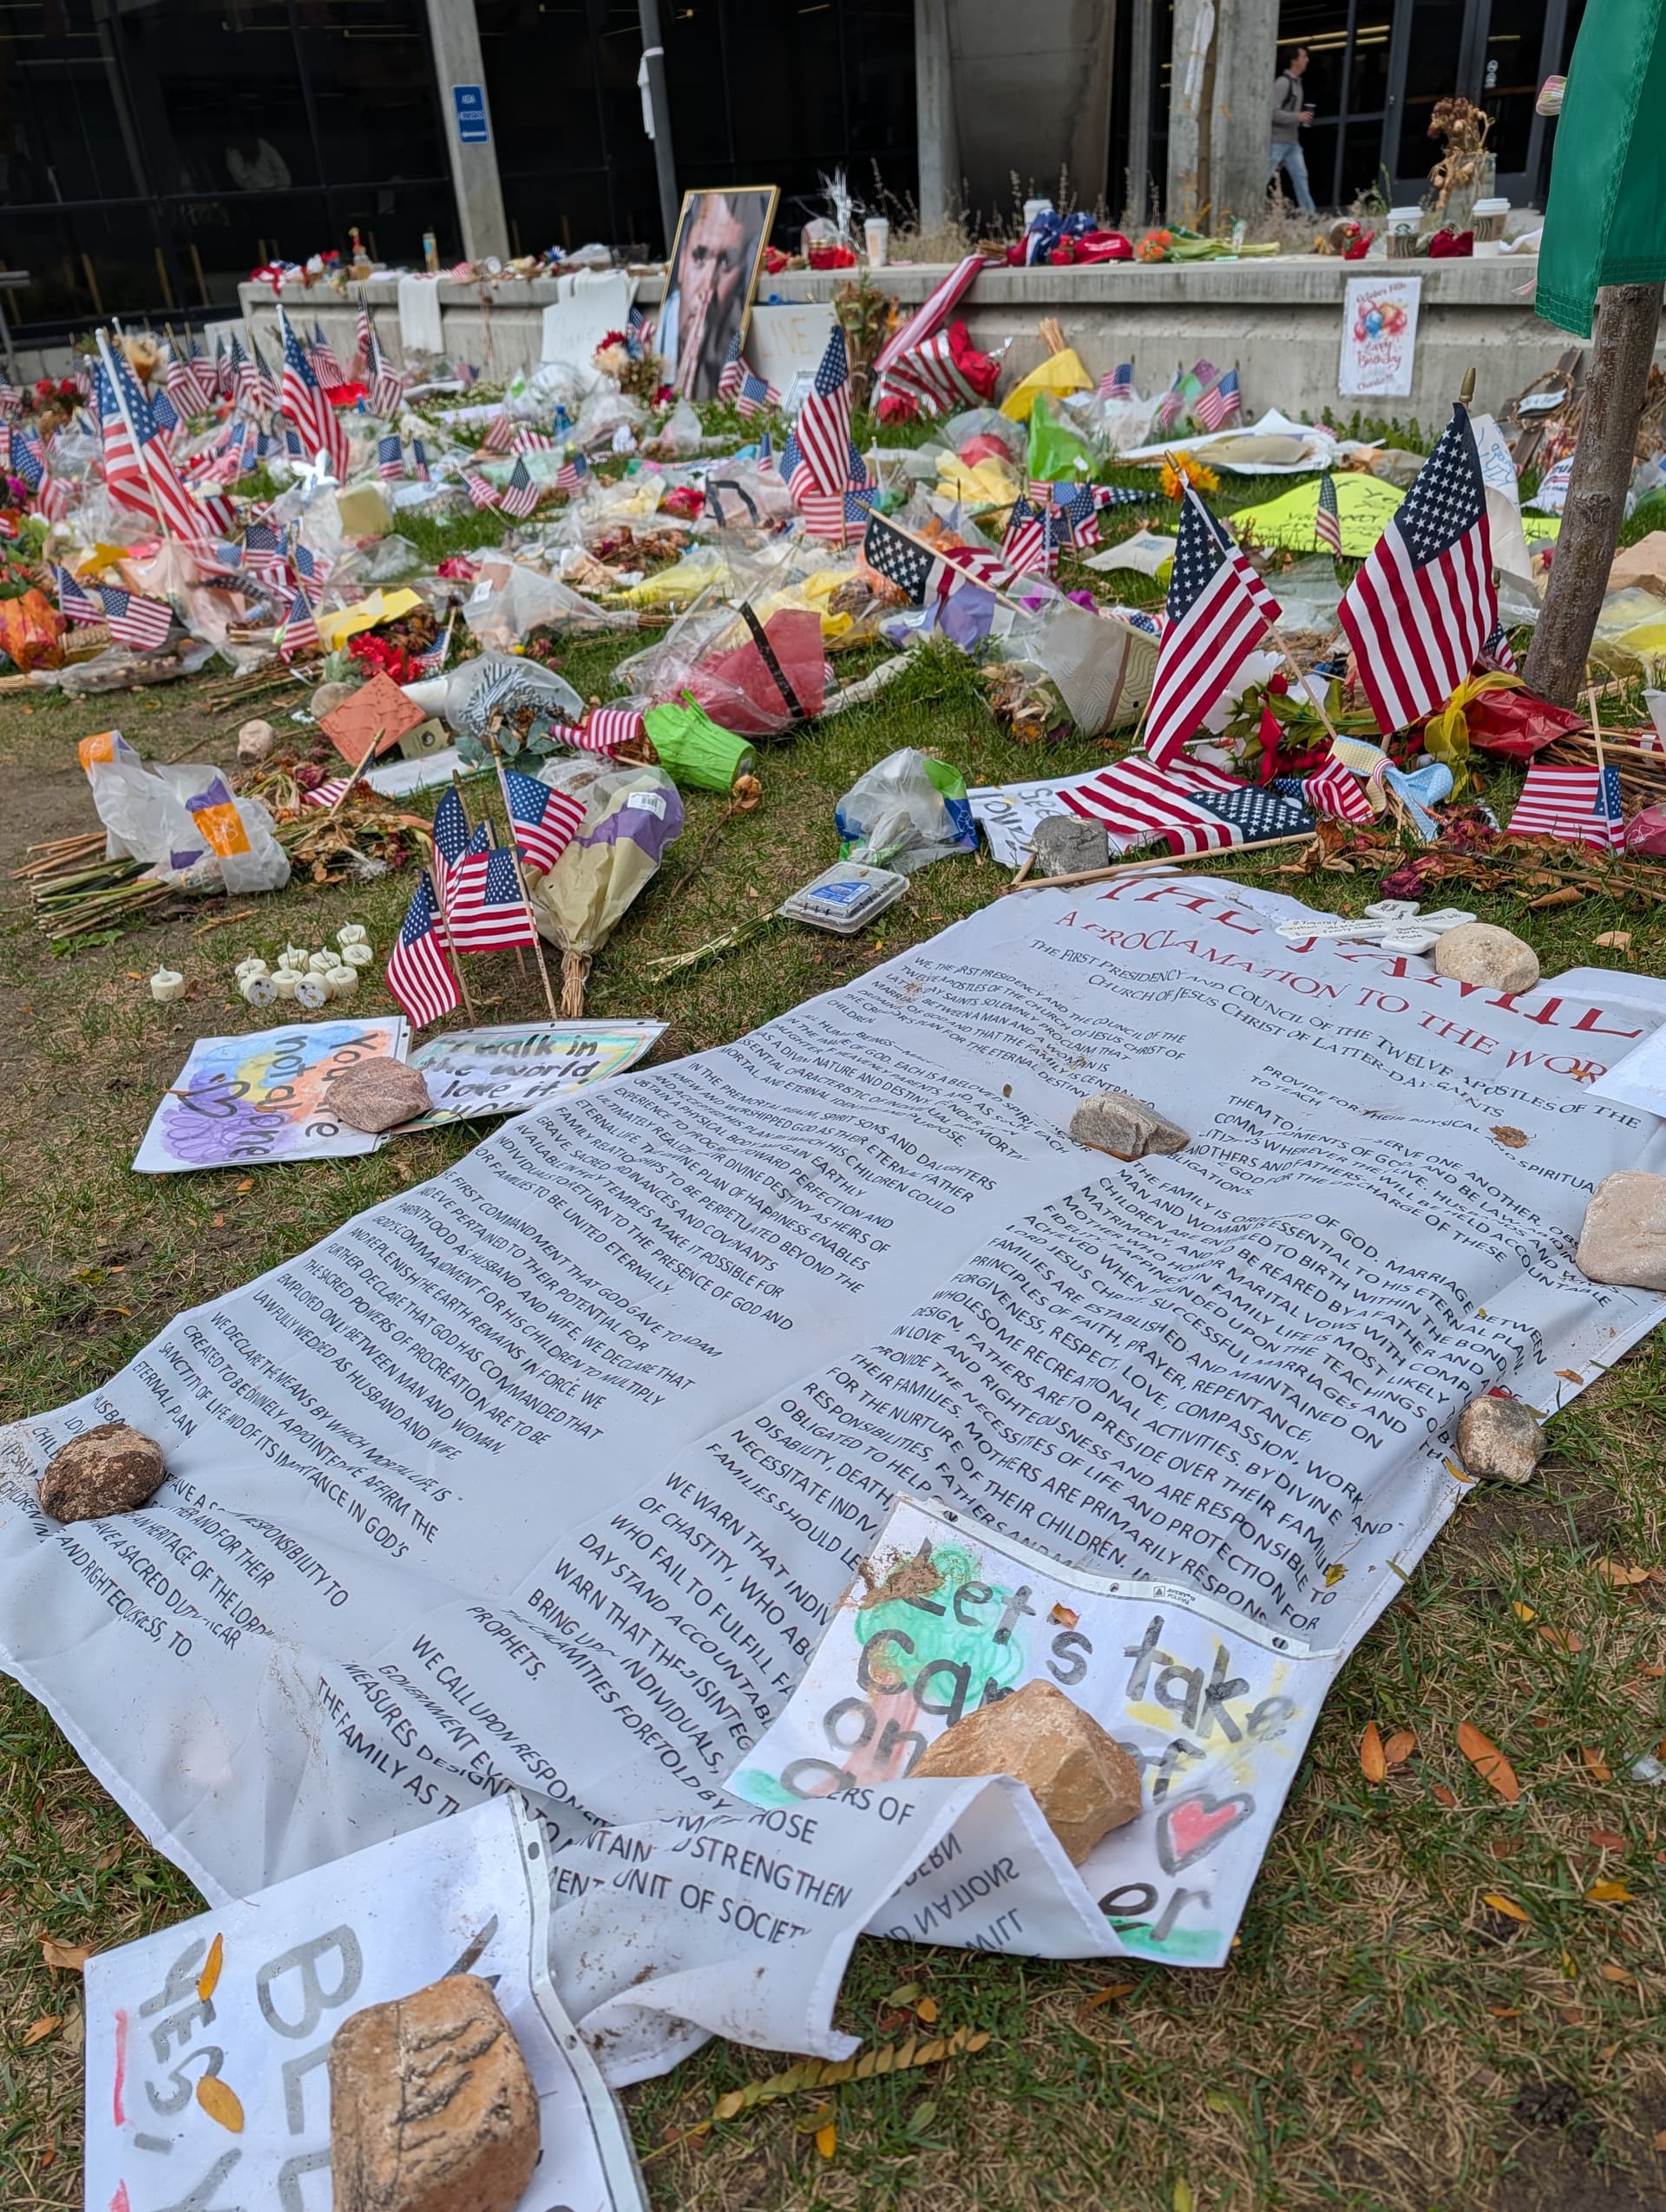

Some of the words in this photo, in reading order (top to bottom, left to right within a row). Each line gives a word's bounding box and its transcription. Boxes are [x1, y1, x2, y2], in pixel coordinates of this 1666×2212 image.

[1357, 350, 1401, 372] Birthday
[915, 957, 932, 971] WE,
[981, 967, 1044, 998] PRESIDENCY
[1092, 1018, 1145, 1040] COUNCIL
[922, 998, 972, 1020] BETWEEN
[981, 998, 1042, 1022] SOLEMNLY
[1039, 1023, 1097, 1054] PROCLAIM
[1026, 1000, 1072, 1031] CHURCH
[1087, 1031, 1124, 1044] JESUS
[1124, 1044, 1166, 1056] CHRIST
[1054, 911, 1078, 926] A
[1081, 922, 1351, 998] PROCLAMATION
[1355, 988, 1409, 1013] TO
[1418, 1011, 1499, 1056] THE
[1505, 1049, 1608, 1084] WOR
[268, 1034, 310, 1080] not
[565, 1034, 599, 1057] in
[812, 1057, 858, 1077] NATURE
[1024, 1044, 1067, 1077] FAMILY
[1030, 939, 1058, 957] THE
[1060, 949, 1100, 965] FIRST
[1097, 960, 1187, 983] PRESIDENCY
[1185, 976, 1225, 991] AND
[1227, 985, 1304, 1024] COUNCIL
[1309, 1016, 1334, 1031] OF
[1335, 1026, 1373, 1041] THE
[1373, 1035, 1454, 1077] TWELVE
[1461, 1075, 1562, 1114] APOSTLES
[1558, 1103, 1587, 1114] OF
[1592, 1104, 1642, 1129] THE
[1087, 974, 1155, 1002] CHURCH
[1156, 990, 1175, 1002] OF
[1171, 986, 1220, 1007] JESUS
[1221, 1003, 1287, 1037] CHRIST
[1287, 1029, 1311, 1042] OF
[1431, 1082, 1505, 1118] SAINTS
[441, 1080, 512, 1099] love
[489, 1060, 600, 1077] world
[946, 1077, 1003, 1103] BELOVED
[989, 1048, 1038, 1071] ETERNAL
[1037, 1070, 1091, 1099] DESTINY
[1274, 1084, 1322, 1108] TEACH
[613, 1087, 673, 1120] EXPERIENCE
[789, 1168, 863, 1219] PERFECTION
[820, 1112, 856, 1124] SPIRIT
[854, 1118, 890, 1135] SONS
[916, 1153, 998, 1191] DAUGHTERS
[1263, 1065, 1328, 1097] PROVIDE
[1518, 1162, 1596, 1194] SPIRITUA
[845, 1155, 909, 1192] CHILDREN
[908, 1188, 955, 1215] COULD
[922, 1172, 974, 1203] FATHER
[478, 1202, 571, 1266] COMMANDMENT
[563, 1207, 608, 1244] UNITED
[602, 1180, 656, 1219] TEMPLES
[652, 1217, 690, 1249] MAKE
[699, 1251, 758, 1287] POSSIBLE
[696, 1168, 728, 1191] PLAN
[744, 1193, 812, 1236] HAPPINESS
[808, 1232, 871, 1273] ENABLES
[830, 1219, 870, 1245] HEIRS
[1450, 1231, 1508, 1263] THESE
[450, 1207, 508, 1251] PERTAINED
[556, 1287, 622, 1333] POTENTIAL
[651, 1248, 714, 1292] PRESENCE
[731, 1297, 764, 1315] GOD
[779, 1240, 835, 1277] BEYOND
[1063, 1195, 1124, 1240] MOTHER
[1225, 1266, 1300, 1319] MARITAL
[1298, 1254, 1350, 1292] BIRTH
[1353, 1289, 1422, 1316] WITHIN
[1385, 1260, 1474, 1314] MARRIAGE
[277, 1273, 325, 1312] EMPLOYED
[451, 1418, 507, 1456] WOMAN,
[968, 1255, 1049, 1307] PRINCIPLES
[1070, 1313, 1123, 1349] FAITH,
[1191, 1379, 1312, 1443] REPENTANCE,
[987, 1238, 1056, 1281] FAMILIES
[1083, 1303, 1187, 1353] ESTABLISHED
[1229, 1370, 1348, 1429] MAINTAINED
[1148, 1298, 1254, 1365] SUCCESSFUL
[345, 1369, 406, 1420] HUSBAND
[407, 1343, 489, 1411] PROCREATION
[479, 1359, 567, 1424] COMMANDED
[597, 1373, 666, 1407] MULTIPLY
[949, 1273, 1046, 1335] FORGIVENESS,
[1048, 1325, 1122, 1371] RESPECT,
[1174, 1401, 1300, 1466] COMPASSION,
[964, 1332, 1036, 1389] FATHERS
[1091, 1411, 1168, 1465] PRESIDE
[802, 1382, 934, 1463] RESPONSIBILITIES,
[931, 1290, 1026, 1352] WHOLESOME
[1142, 1419, 1242, 1467] ACTIVITIES.
[1274, 1472, 1342, 1527] DIVINE
[731, 1429, 831, 1505] NECESSITATE
[755, 1416, 836, 1472] DISABILITY,
[835, 1462, 895, 1512] DEATH,
[780, 1399, 863, 1450] OBLIGATED
[885, 1459, 932, 1494] HELP
[893, 1378, 963, 1419] FAMILIES.
[1079, 1495, 1184, 1565] PRIMARILY
[361, 1475, 411, 1517] AFFIRM
[692, 1490, 747, 1537] WARN
[888, 1408, 965, 1455] NURTURE
[1036, 1511, 1128, 1569] CHILDREN.
[962, 1392, 1058, 1457] NECESSITIES
[1166, 1518, 1288, 1605] PROTECTION
[143, 1521, 198, 1567] HERITAGE
[364, 1515, 410, 1558] GOD'S
[772, 1499, 842, 1553] SHOULD
[611, 1563, 670, 1613] STAND
[661, 1511, 739, 1583] CHASTITY,
[739, 1575, 785, 1626] WHO
[466, 1606, 548, 1681] PROPHETS.
[649, 1545, 688, 1587] FAIL
[708, 1602, 774, 1675] FULFILL
[377, 1664, 480, 1752] GOVERNMENT
[436, 1665, 476, 1707] CALL
[469, 1701, 520, 1744] UPON
[528, 1587, 580, 1638] BRING
[620, 1658, 725, 1776] INDIVIDUALS,
[1124, 1614, 1298, 1744] take
[613, 1705, 702, 1790] FORETOLD
[340, 1661, 419, 1749] MEASURES
[690, 1835, 856, 1910] STRENGTHEN
[612, 1867, 673, 1901] UNIT
